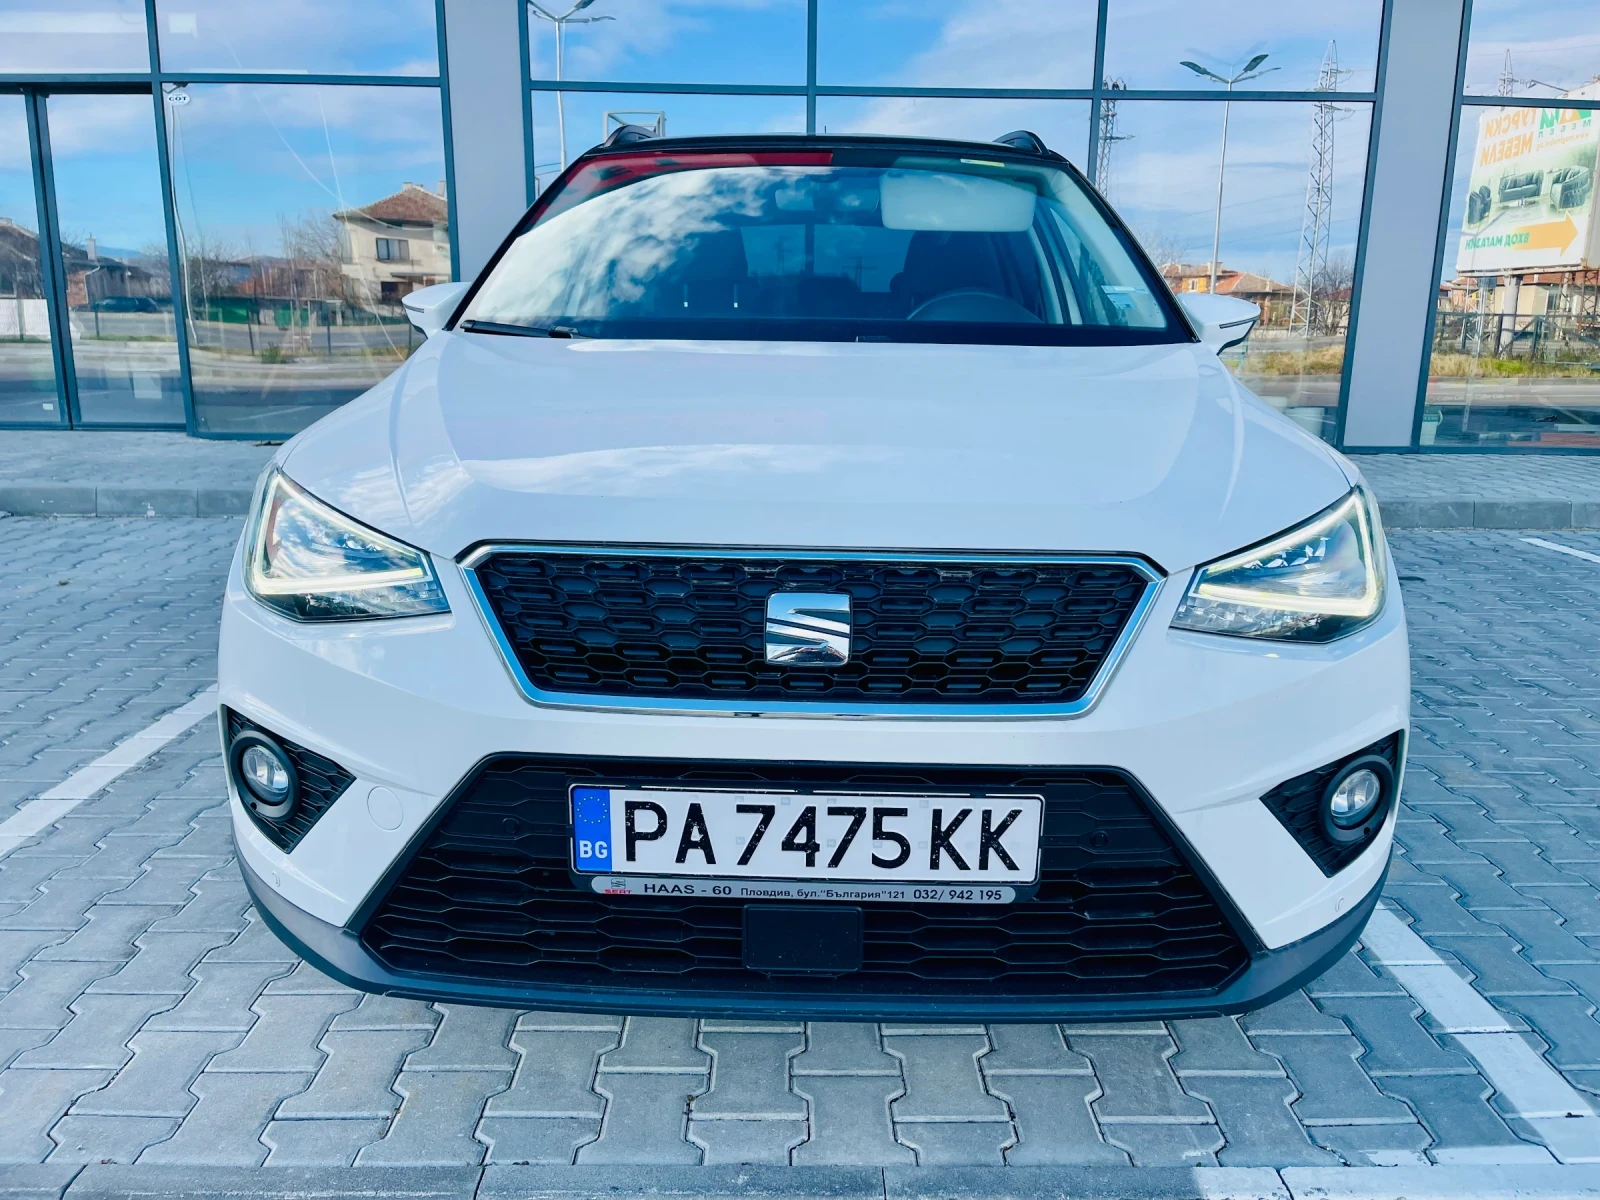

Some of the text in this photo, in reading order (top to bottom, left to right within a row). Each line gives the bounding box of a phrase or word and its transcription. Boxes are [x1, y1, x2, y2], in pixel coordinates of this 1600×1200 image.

[624, 800, 1023, 871] PA 7475 KK
[579, 840, 608, 859] BG
[643, 883, 695, 895] HAAS
[712, 885, 733, 896] 60
[740, 887, 794, 898] Пловдив,
[913, 889, 945, 901] 032/
[949, 889, 973, 900] 942
[979, 890, 1002, 900] 195
